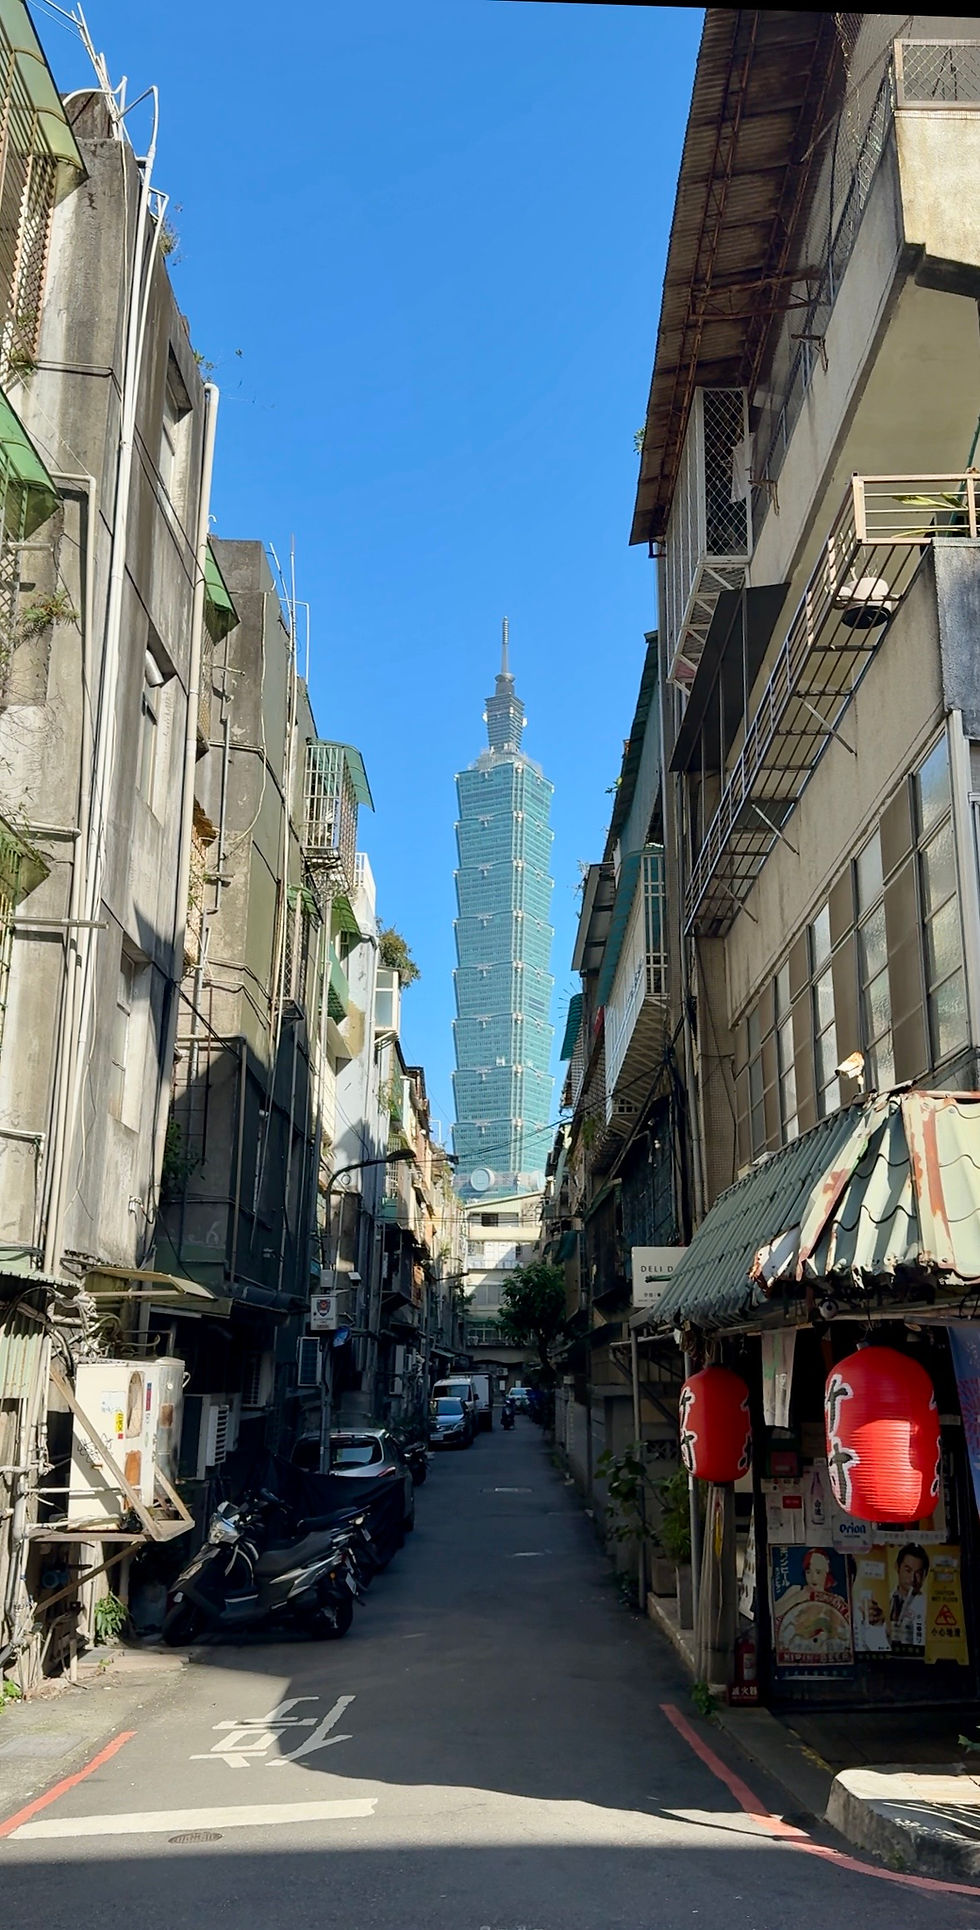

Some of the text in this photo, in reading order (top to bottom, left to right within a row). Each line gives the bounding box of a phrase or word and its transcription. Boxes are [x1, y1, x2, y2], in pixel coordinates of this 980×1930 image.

[640, 1265, 663, 1273] DELI
[839, 1522, 866, 1534] Orion
[731, 1686, 758, 1696] 滅火器
